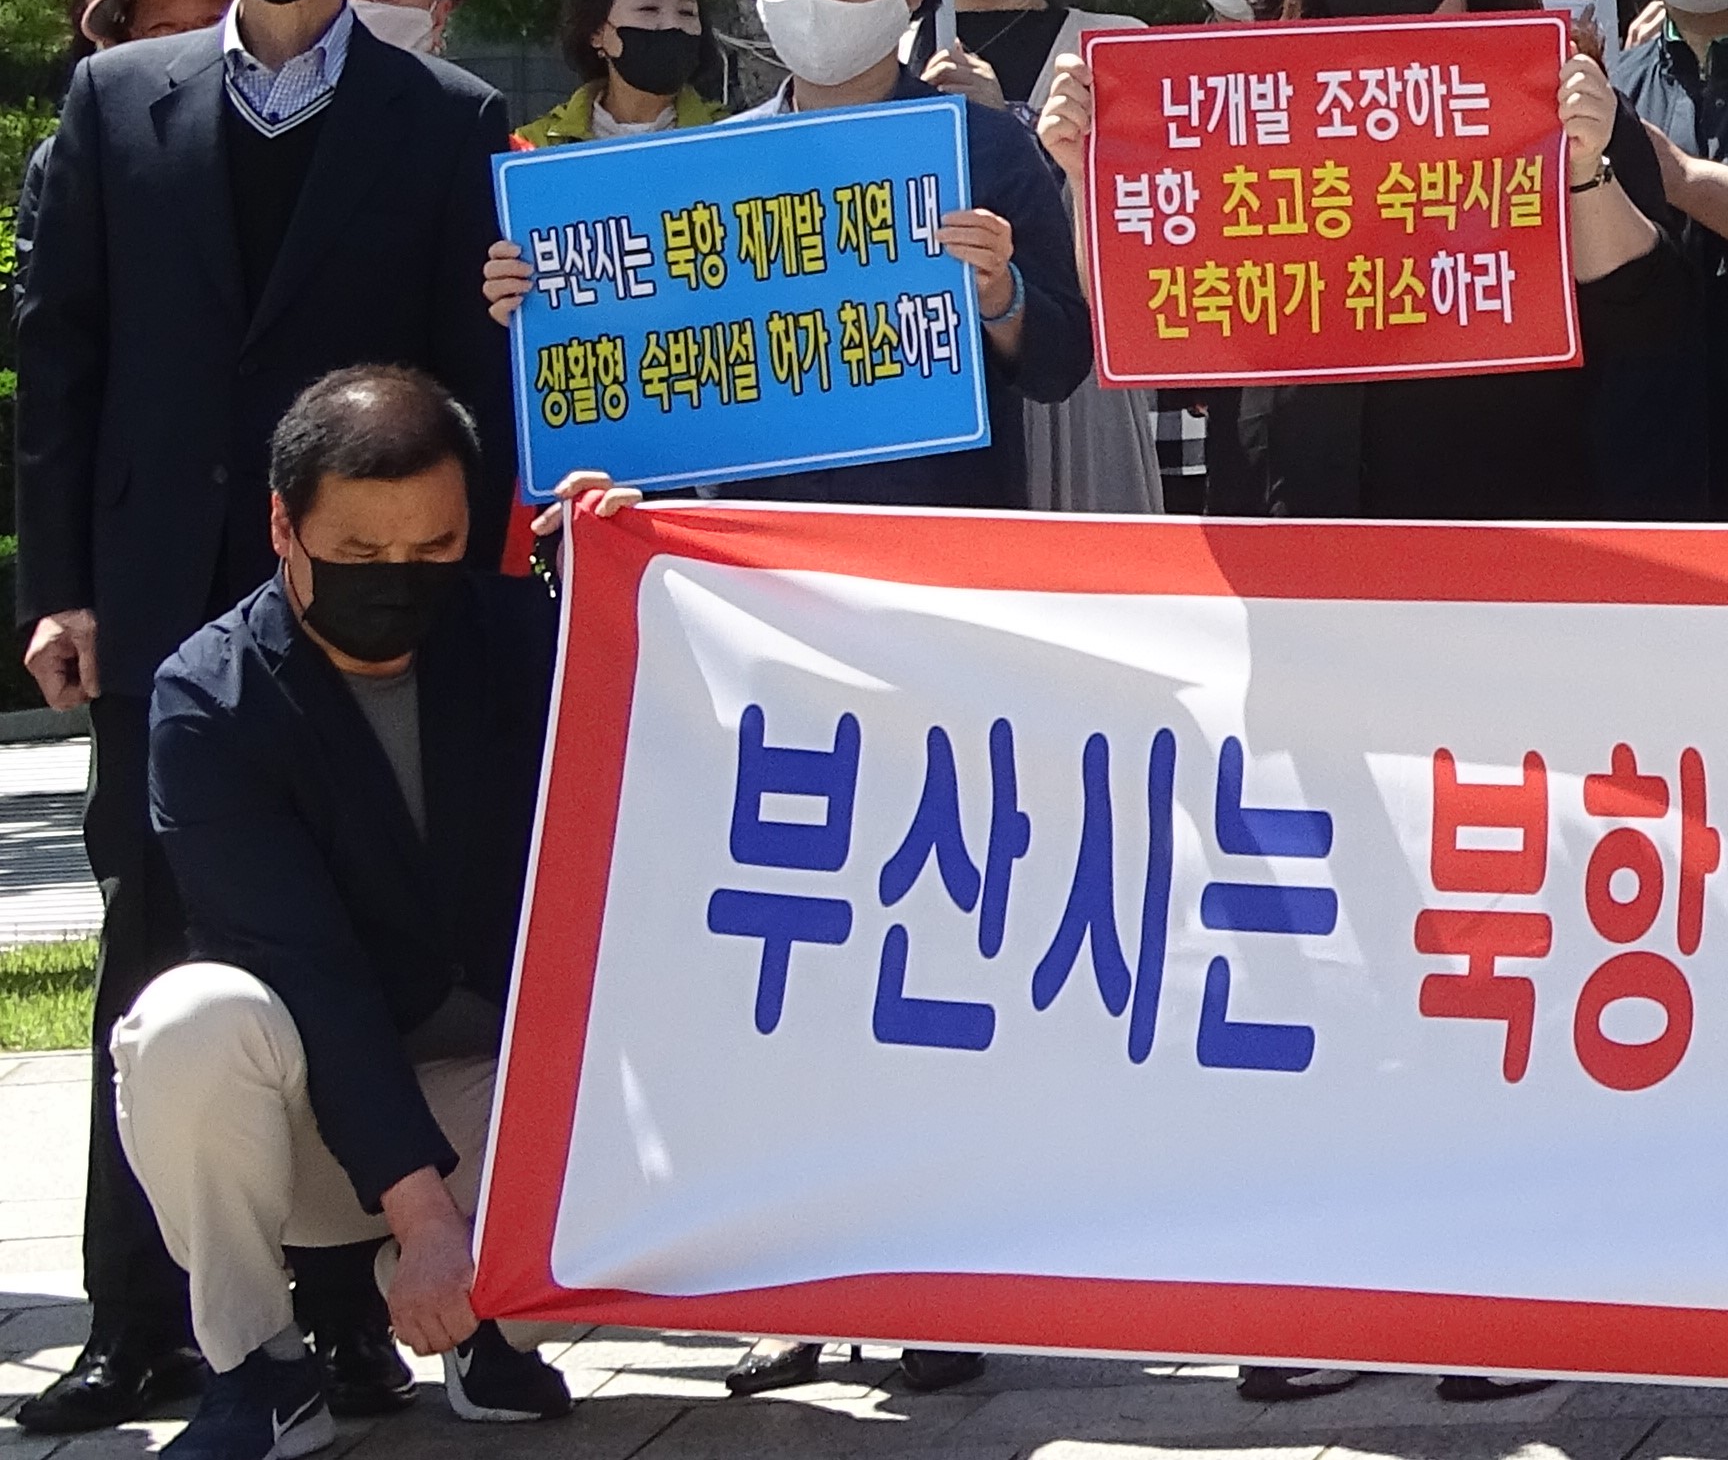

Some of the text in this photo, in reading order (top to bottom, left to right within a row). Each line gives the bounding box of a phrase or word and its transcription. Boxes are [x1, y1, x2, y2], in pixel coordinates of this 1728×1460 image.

[1161, 61, 1491, 149] 난개발 조장하는
[529, 174, 943, 309] 부산시는 북항 재개발 지역 내
[1113, 154, 1544, 246] 북항 초고층 숙박시설
[1147, 249, 1515, 339] 건축허가 취소하라
[534, 291, 960, 428] 생활형 숙박시설 허가 취소하라
[708, 702, 1339, 1073] 부산시는
[1413, 743, 1720, 1092] 북항
